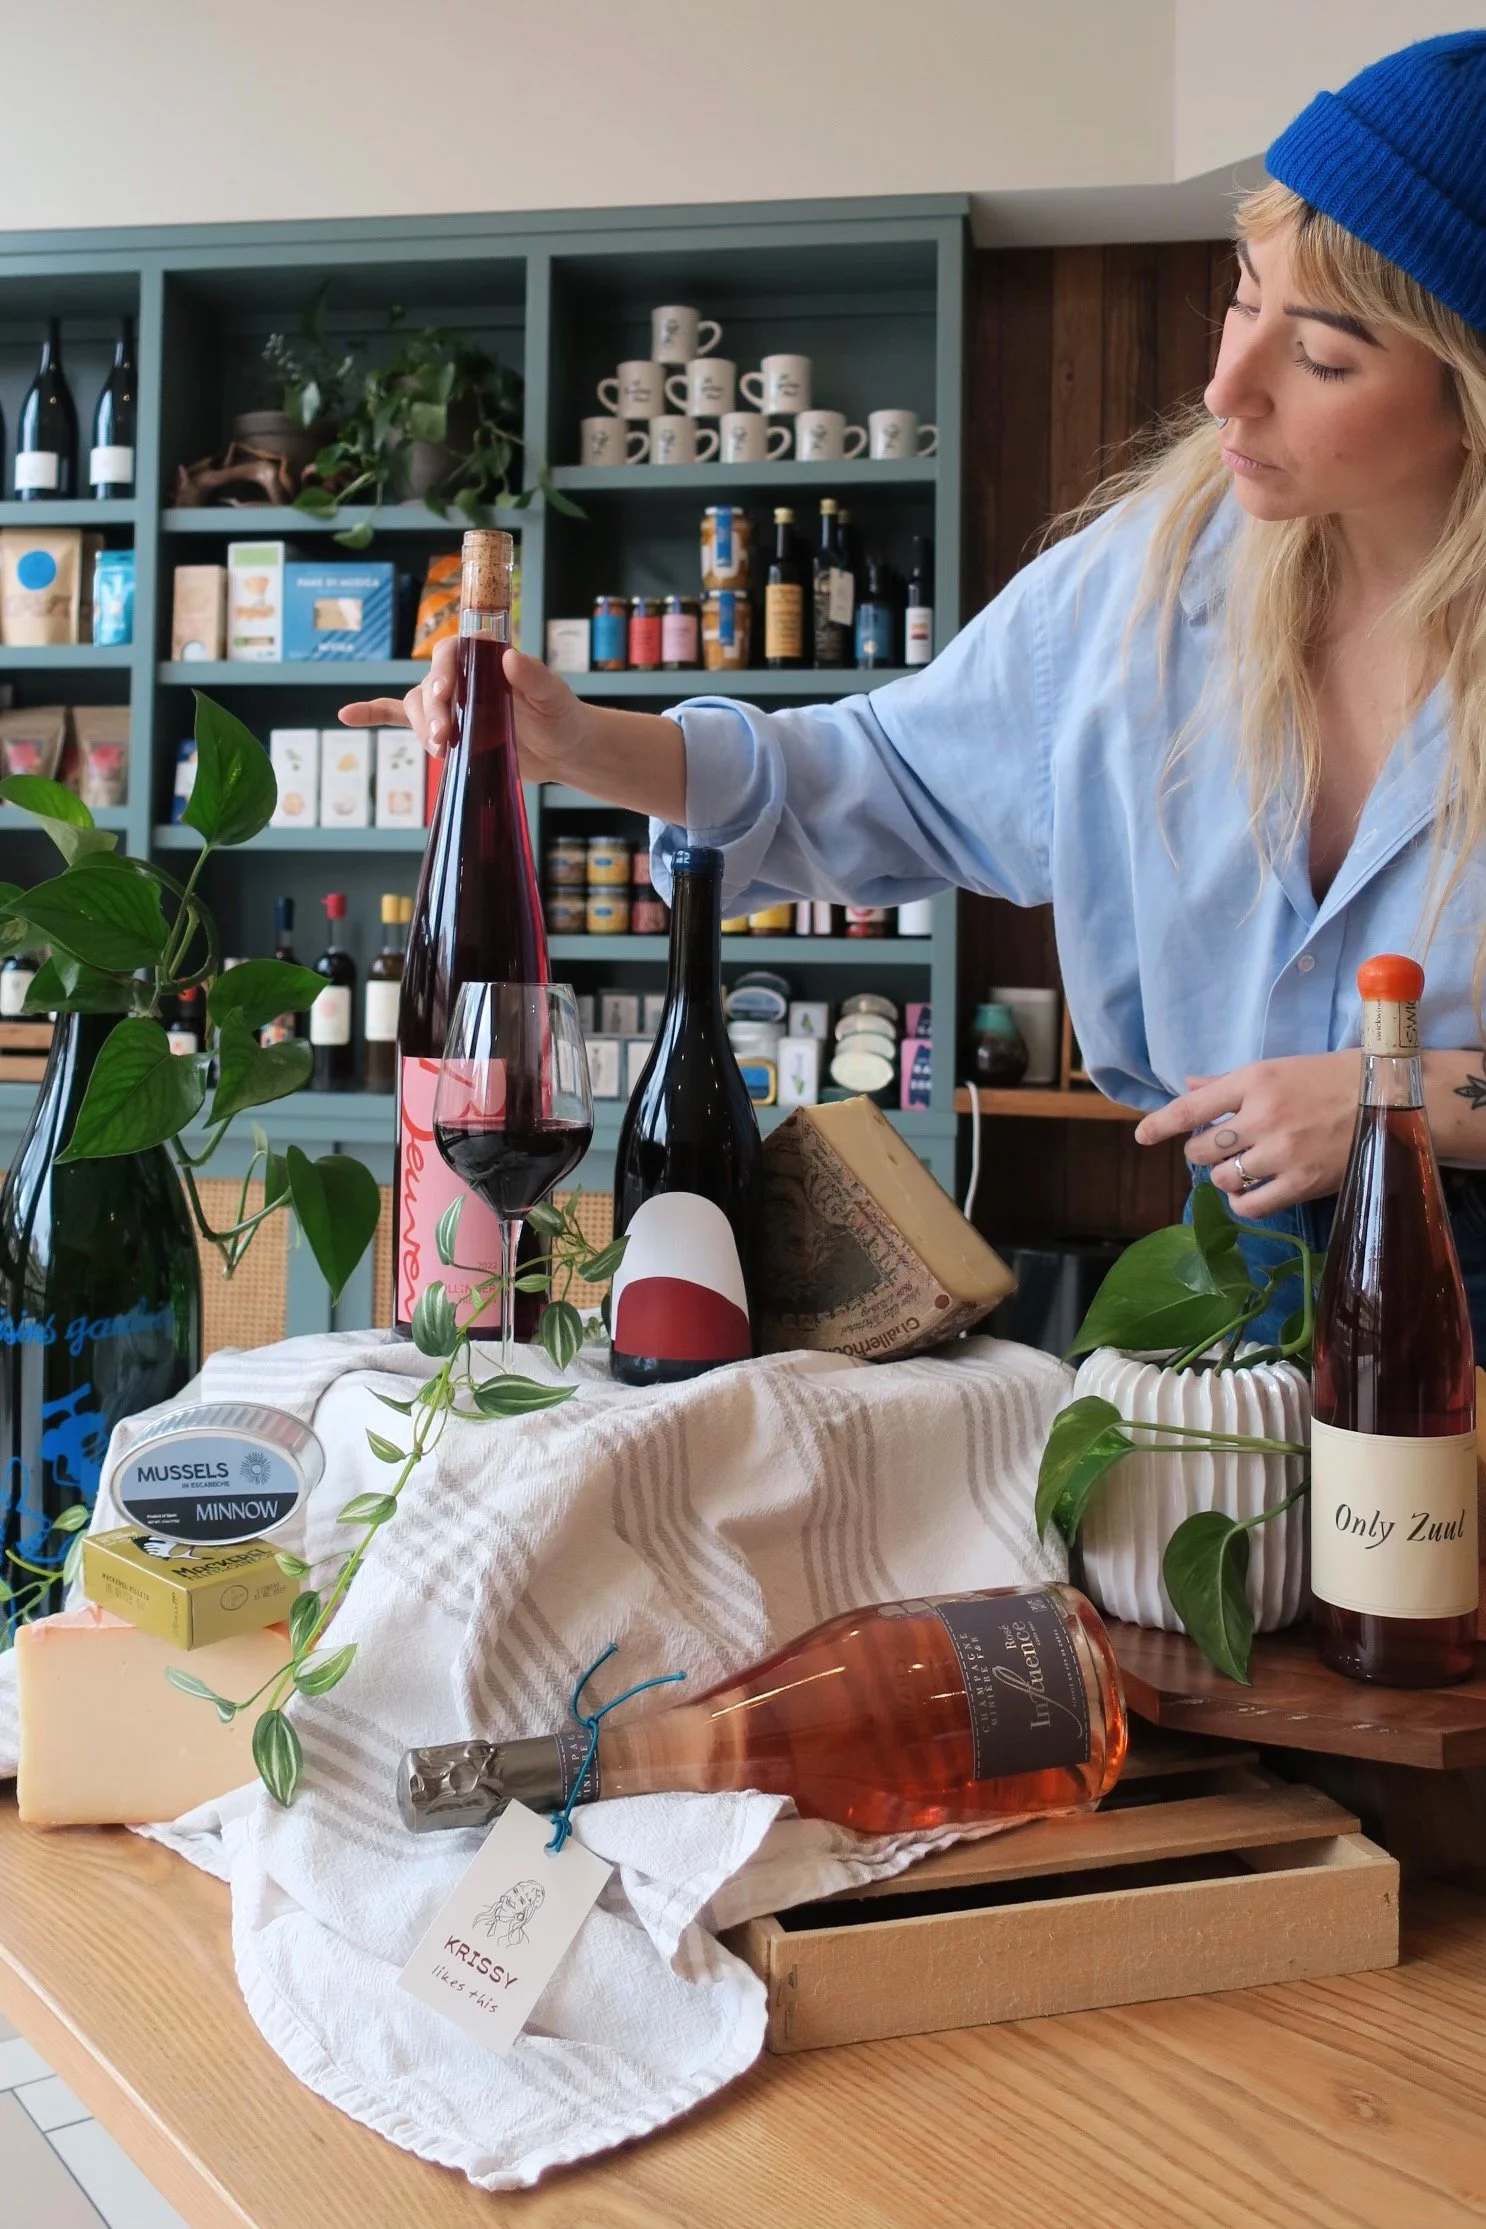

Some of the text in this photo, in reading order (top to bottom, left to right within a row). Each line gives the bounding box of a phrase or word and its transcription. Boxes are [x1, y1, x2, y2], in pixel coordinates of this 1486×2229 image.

[137, 1462, 230, 1483] MUSSELS
[196, 1500, 279, 1522] MINNOW
[1335, 1503, 1466, 1550] Only Zuul
[998, 1624, 1017, 1651] Rosé
[959, 1632, 990, 1734] CHAMPAGNE
[992, 1620, 1083, 1739] Influence
[444, 1935, 519, 1990] KRISSY
[432, 1964, 498, 2013] likes this
